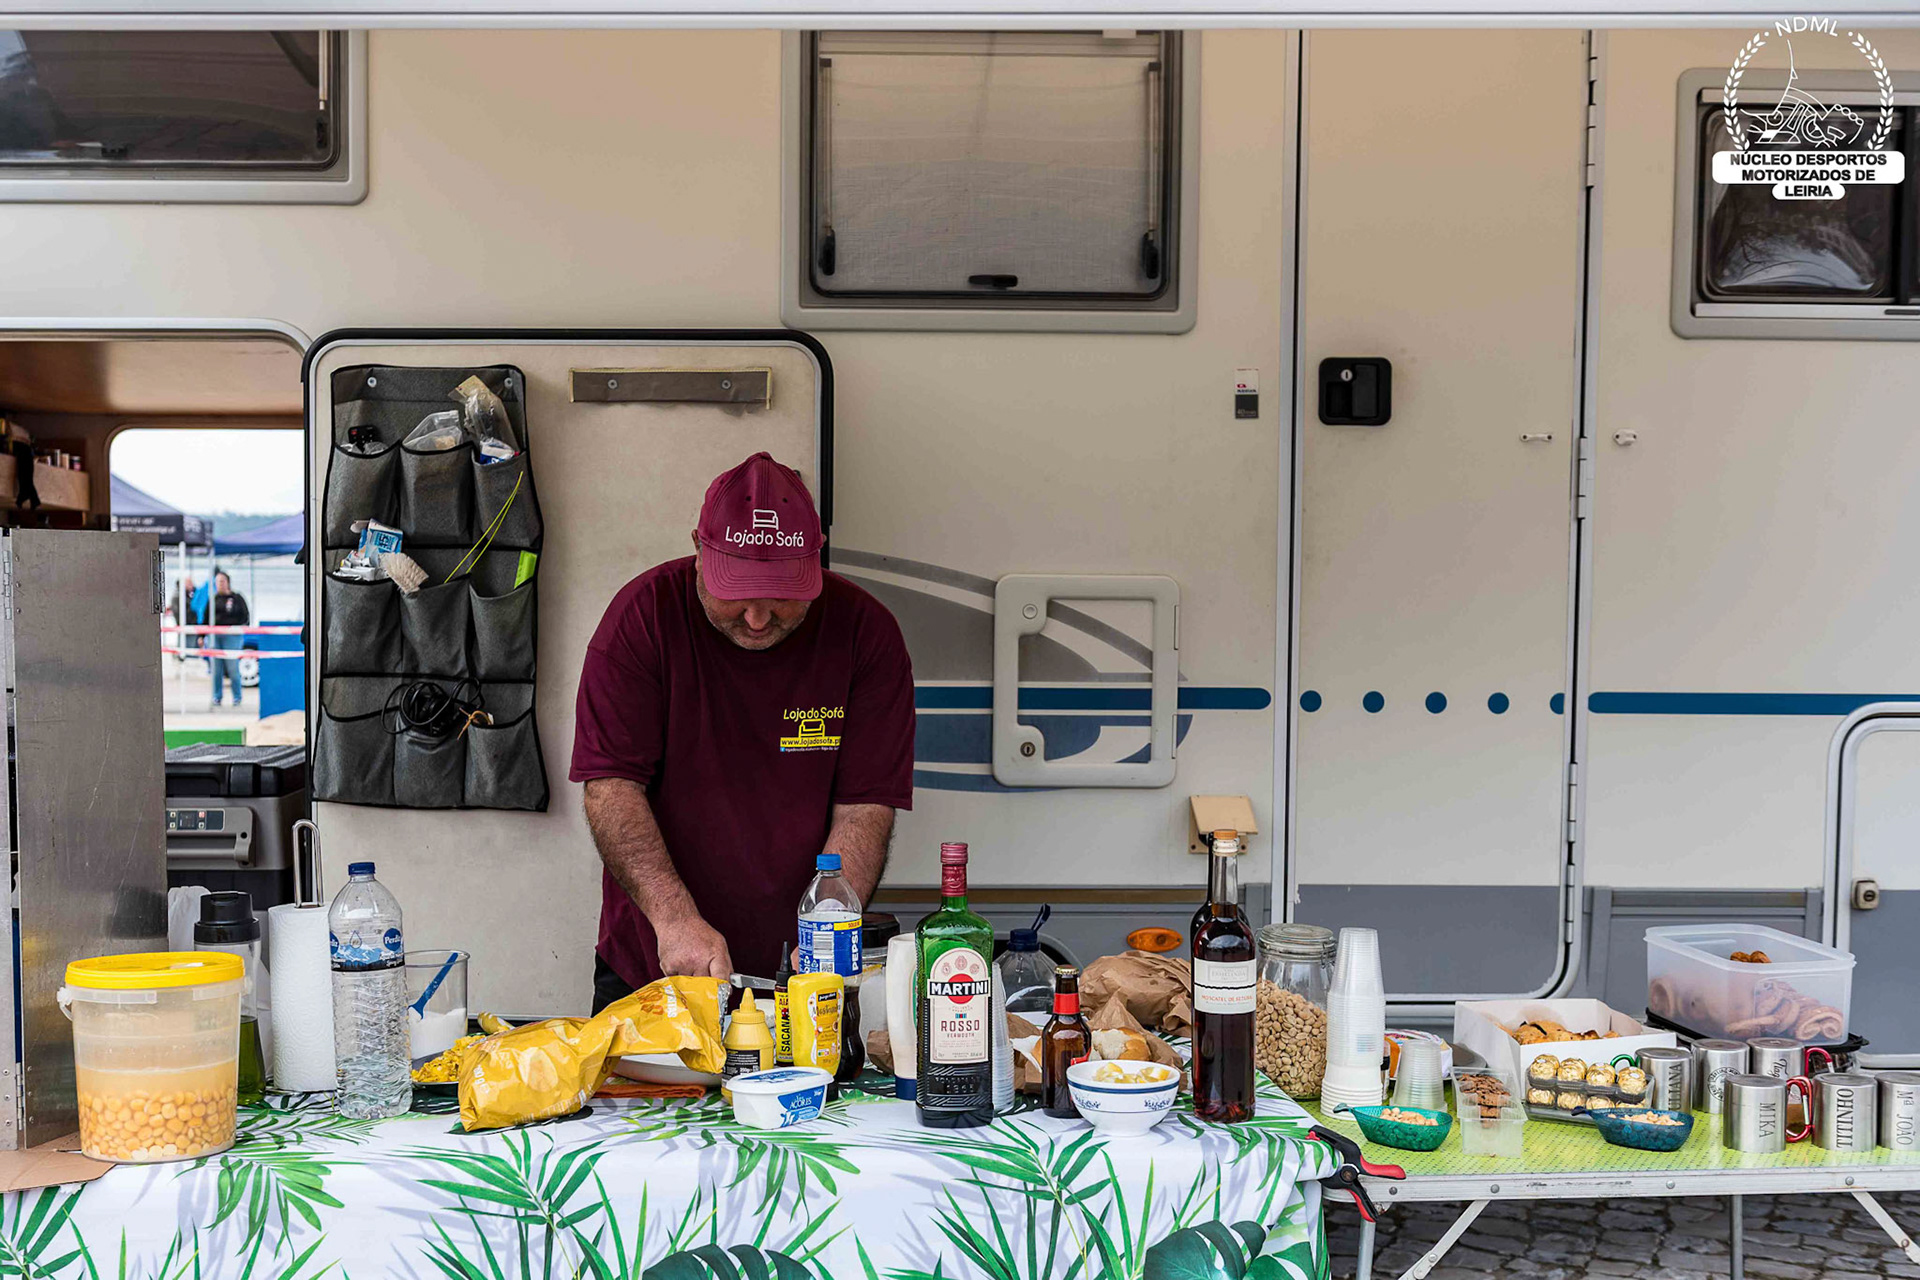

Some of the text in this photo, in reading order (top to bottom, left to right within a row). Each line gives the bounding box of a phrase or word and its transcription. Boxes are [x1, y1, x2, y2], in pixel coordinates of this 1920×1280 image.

[776, 531, 805, 548] Sofá
[820, 706, 845, 719] Sofá
[781, 737, 840, 747] www.lojadosofa.p
[851, 930, 859, 971] PEPSI
[931, 981, 988, 995] MARTINI
[781, 1013, 791, 1052] SACANA
[940, 1019, 980, 1032] ROSSO
[1668, 1063, 1683, 1111] ULIANA
[1758, 1102, 1776, 1138] MIKA
[1836, 1088, 1855, 1149] TITINHO
[1896, 1113, 1916, 1146] JOÃO
